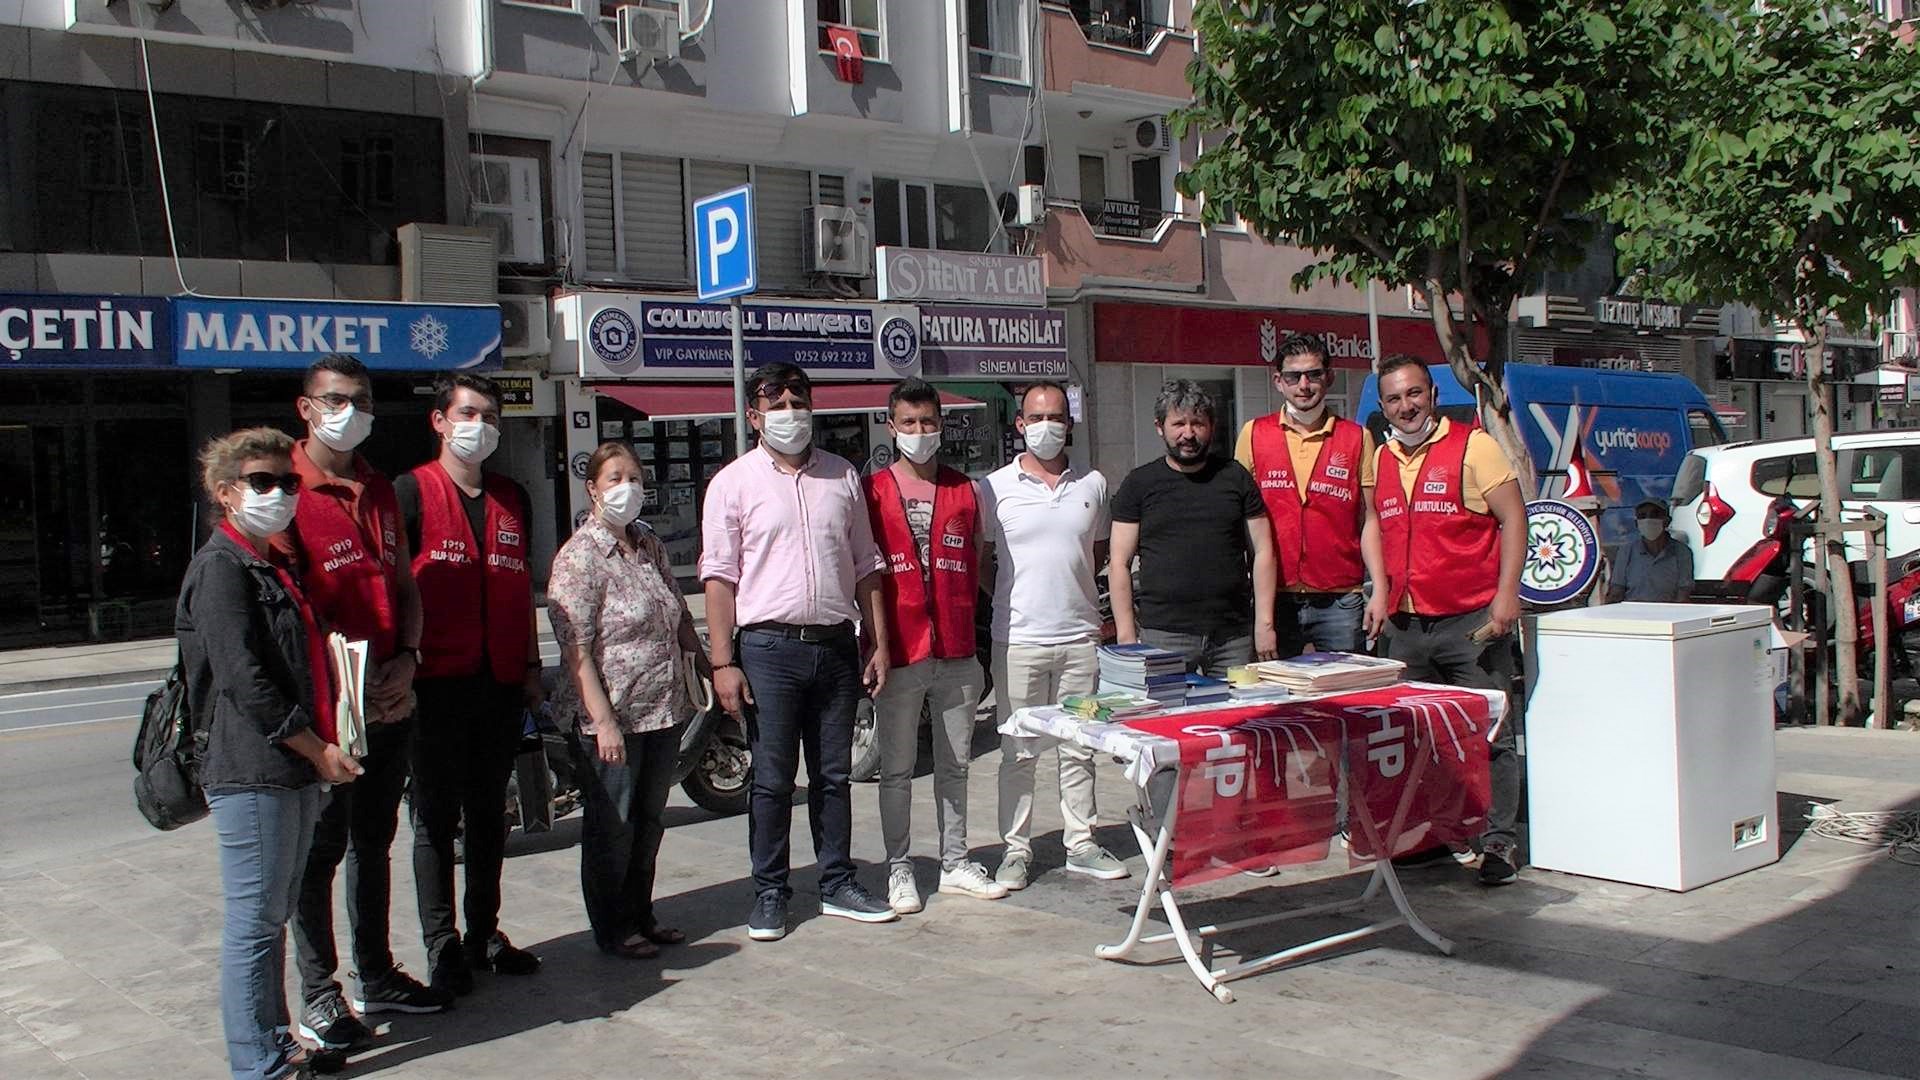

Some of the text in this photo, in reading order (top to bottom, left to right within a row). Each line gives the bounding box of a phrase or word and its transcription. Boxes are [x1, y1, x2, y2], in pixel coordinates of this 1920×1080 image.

[708, 207, 739, 287] P
[927, 255, 1042, 294] RENT A CAR
[0, 300, 389, 360] ÇETİN MARKET
[768, 312, 853, 336] BANKER
[921, 313, 1063, 345] FATURA TAHSİLAT
[655, 348, 673, 361] VIP
[794, 350, 819, 362] 0252
[821, 351, 840, 363] 692
[842, 352, 854, 364] 22
[856, 353, 868, 364] 32
[979, 359, 1067, 376] SİNEM İLETİŞİM
[1268, 470, 1287, 479] 1919
[1328, 467, 1347, 478] CHP
[1426, 483, 1445, 492] CHP
[1414, 500, 1458, 516] KURTULUŞA
[442, 539, 466, 550] 1919
[500, 533, 518, 542] CHP
[944, 536, 962, 545] CHP
[330, 539, 353, 554] 1919
[1342, 705, 1404, 777] CHP
[1181, 725, 1246, 797] CHP
